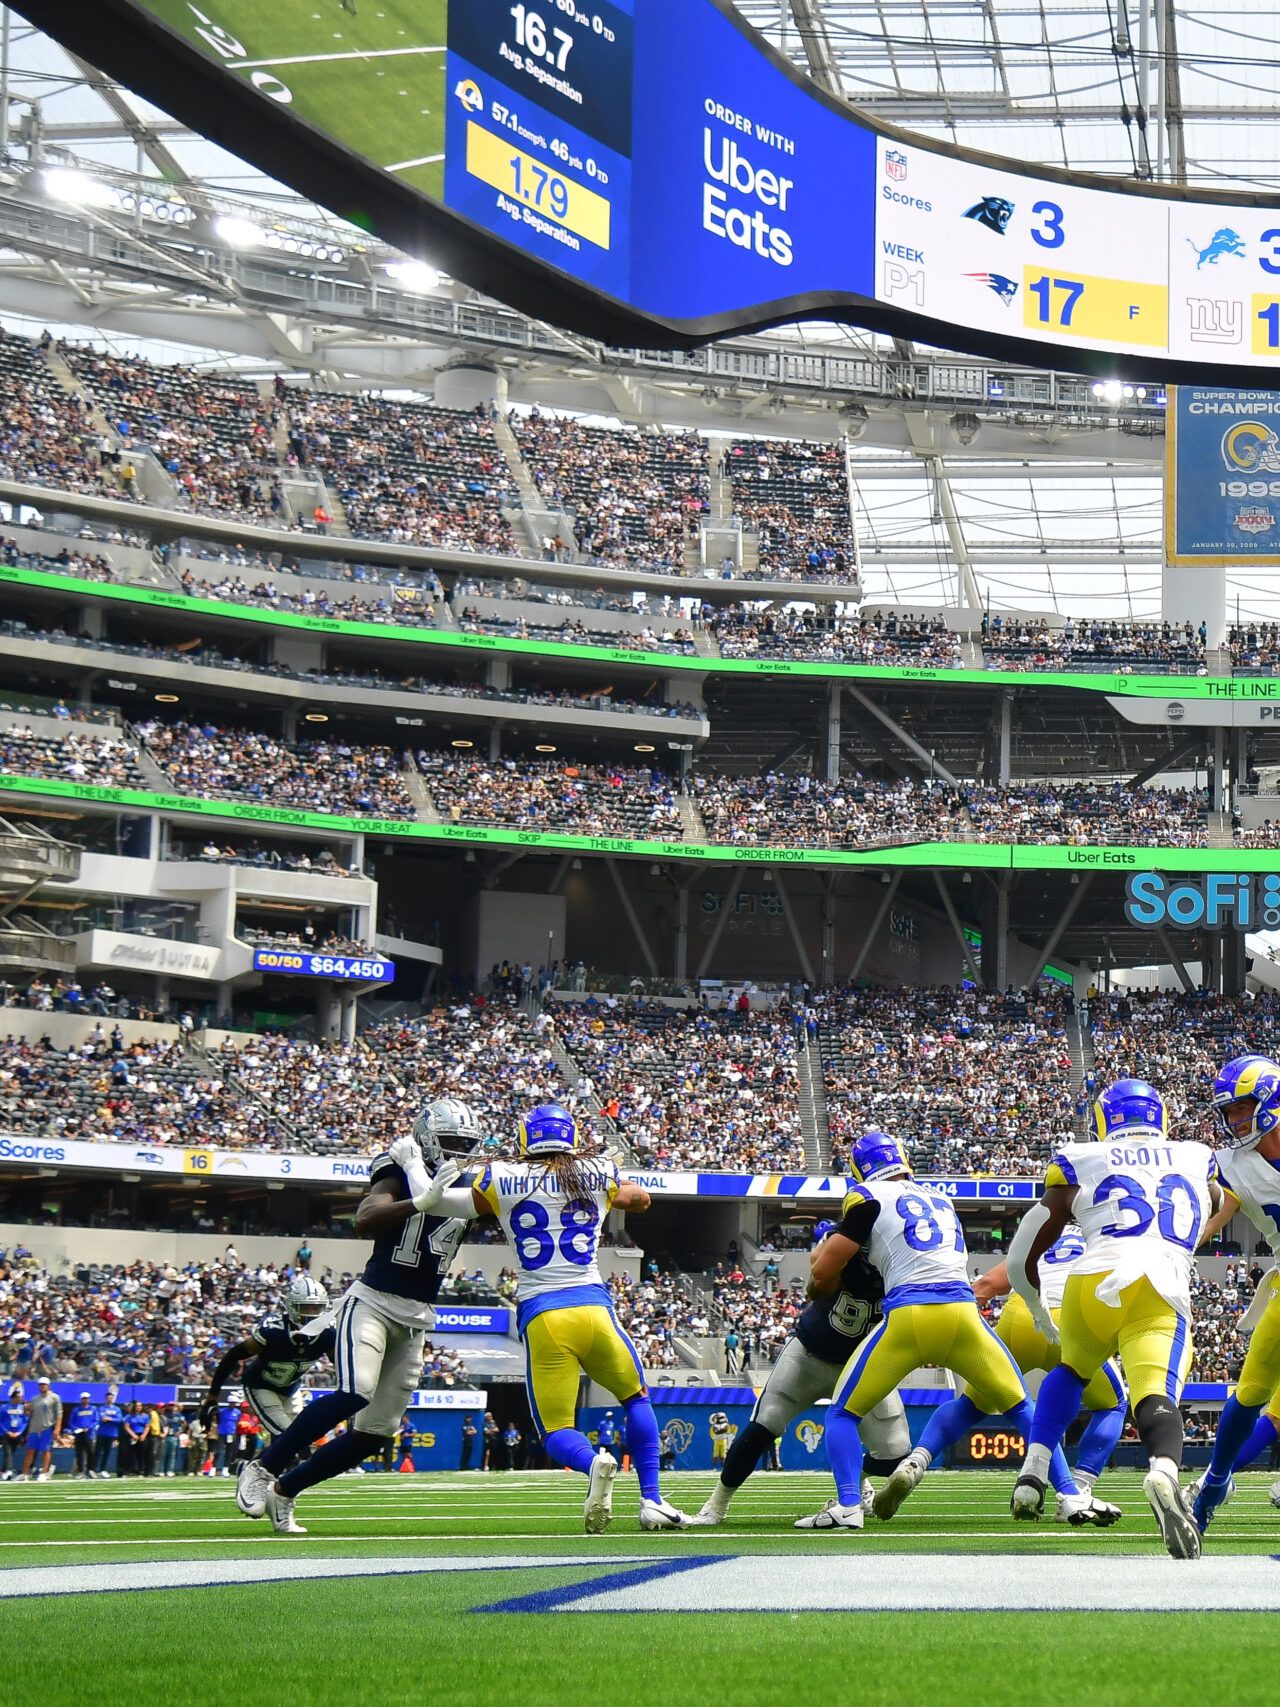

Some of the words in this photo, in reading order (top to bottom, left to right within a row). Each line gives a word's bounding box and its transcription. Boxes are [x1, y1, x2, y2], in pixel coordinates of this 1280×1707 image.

[510, 3, 573, 72] 16.7
[499, 42, 525, 70] Avg.
[525, 58, 583, 104] Separation
[704, 98, 752, 135] ORDER
[755, 124, 795, 156] WITH
[704, 127, 794, 212] Uber
[510, 156, 569, 218] 1.79
[882, 186, 932, 212] Scores
[496, 194, 522, 220] Avg.
[523, 208, 580, 251] Separation
[703, 182, 795, 267] Eats
[1031, 201, 1065, 248] 3
[882, 240, 925, 264] WEEK
[884, 260, 925, 307] P1
[1030, 275, 1084, 326] 17
[1129, 305, 1140, 322] F
[1192, 392, 1236, 400] SUPER
[1238, 392, 1275, 400] BOWL
[756, 663, 772, 671] Uber
[902, 669, 919, 677] Uber
[920, 670, 937, 678] Eats
[1206, 682, 1238, 697] THE
[1242, 683, 1277, 697] LINE
[74, 786, 97, 798] THE
[98, 788, 122, 800] LINE
[155, 797, 178, 808] Uber
[180, 799, 202, 810] Eats
[233, 806, 272, 821] ORDER
[273, 809, 306, 823] FROM
[351, 820, 383, 832] YOUR
[384, 822, 411, 834] SEAT
[443, 828, 464, 838] Uber
[466, 829, 487, 839] Eats
[518, 833, 541, 843] SKIP
[590, 838, 609, 849] THE
[611, 840, 633, 851] LINE
[663, 845, 683, 854] Uber
[684, 846, 705, 855] Eats
[735, 849, 771, 860] ORDER
[772, 850, 804, 861] FROM
[1067, 851, 1101, 864] Uber
[1103, 852, 1136, 864] Eats
[1129, 872, 1250, 926] SoFi
[258, 954, 303, 968] 50/50
[310, 956, 385, 978] $64,450
[1111, 1133, 1126, 1141] LOS
[0, 1139, 65, 1161] Scores
[1110, 1147, 1173, 1167] SCOTT
[190, 1156, 208, 1169] 16
[280, 1159, 291, 1174] 3
[628, 1176, 667, 1188] FINAL
[997, 1184, 1014, 1196] Q1
[896, 1193, 965, 1254] 87
[1092, 1173, 1201, 1253] 30
[391, 1210, 469, 1275] 14
[510, 1200, 600, 1270] 88
[436, 1314, 492, 1326] HOUSE
[424, 1396, 435, 1404] 1st
[445, 1395, 454, 1404] 10
[970, 1433, 1025, 1459] 0:04
